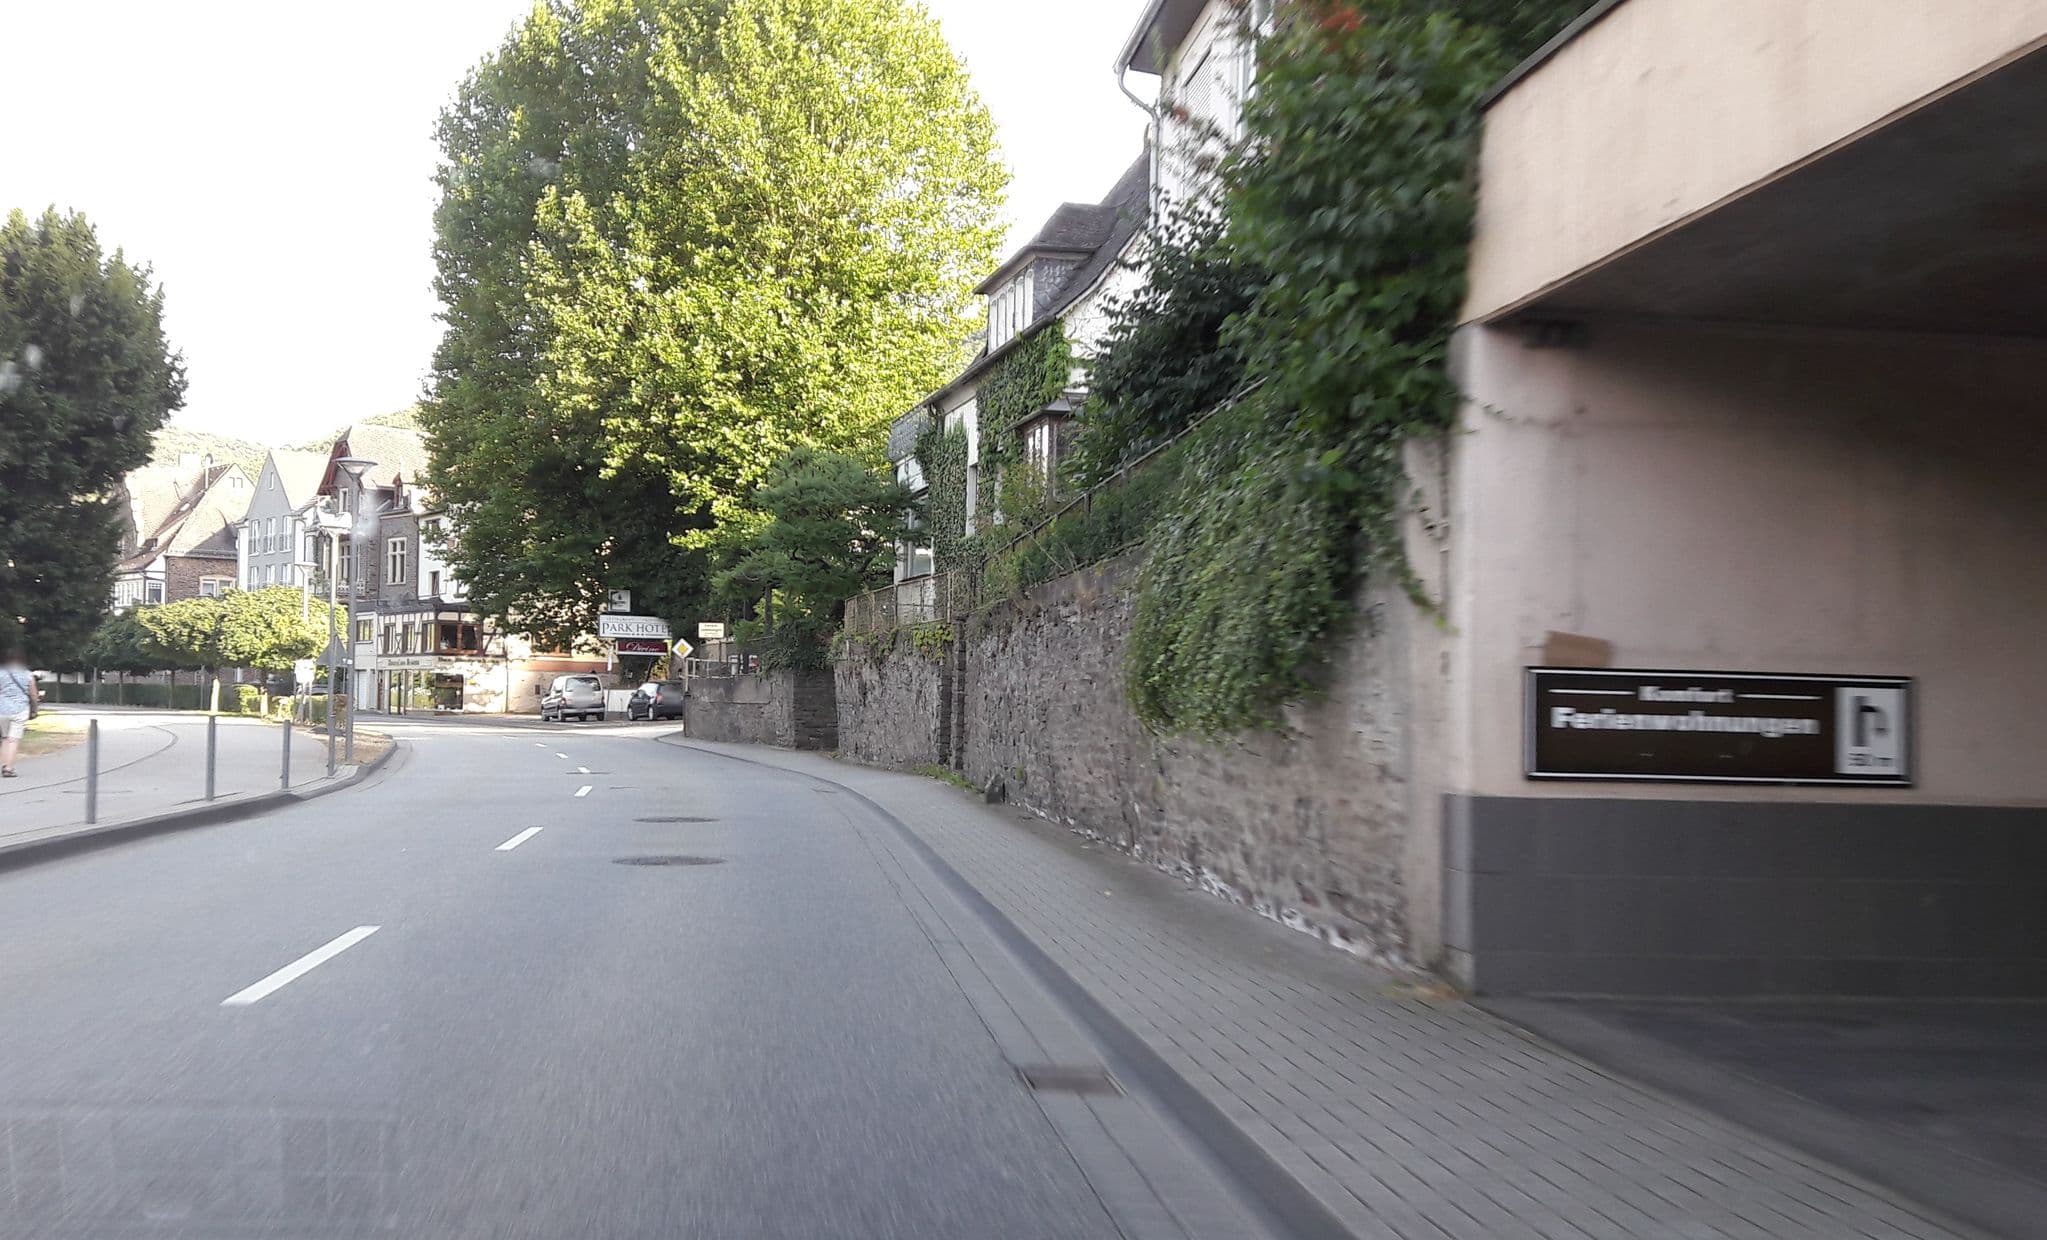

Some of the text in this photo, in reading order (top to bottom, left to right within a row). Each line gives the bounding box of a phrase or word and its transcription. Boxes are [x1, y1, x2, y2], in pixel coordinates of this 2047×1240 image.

[602, 622, 669, 634] PARK HOTE
[1550, 706, 1822, 738] Ferienwohnungen
